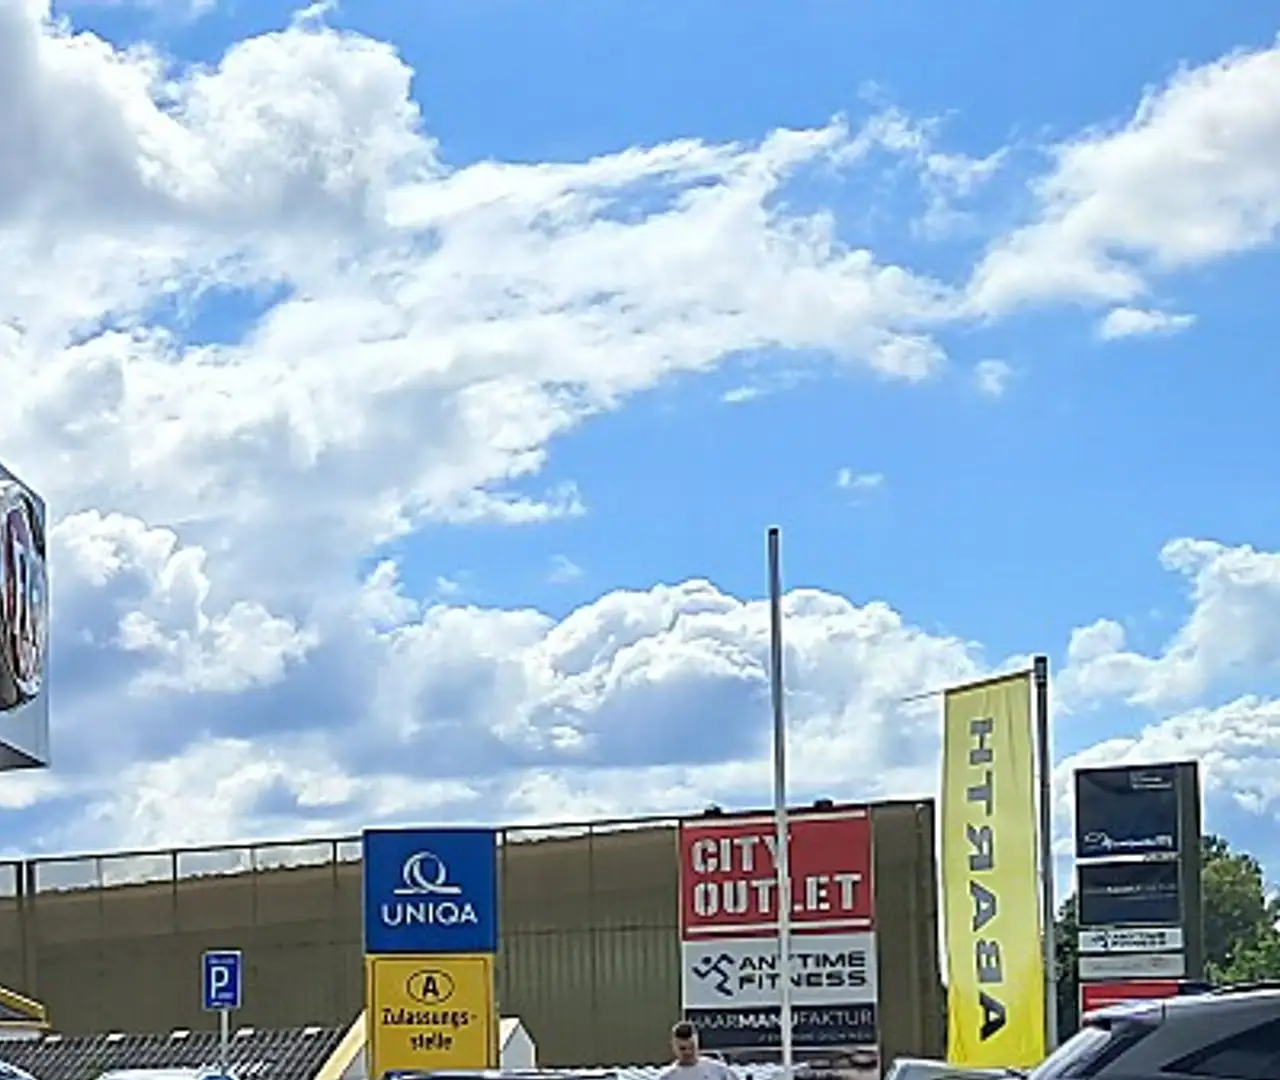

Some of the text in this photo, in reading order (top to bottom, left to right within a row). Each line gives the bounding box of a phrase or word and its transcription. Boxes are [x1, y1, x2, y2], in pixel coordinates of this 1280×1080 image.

[691, 834, 792, 873] CITY
[381, 902, 479, 925] UNIQA
[210, 966, 230, 1000] P
[421, 975, 440, 999] A
[738, 970, 868, 991] FITNESS
[381, 1007, 478, 1030] Zulassungs-
[409, 1032, 453, 1051] stelle
